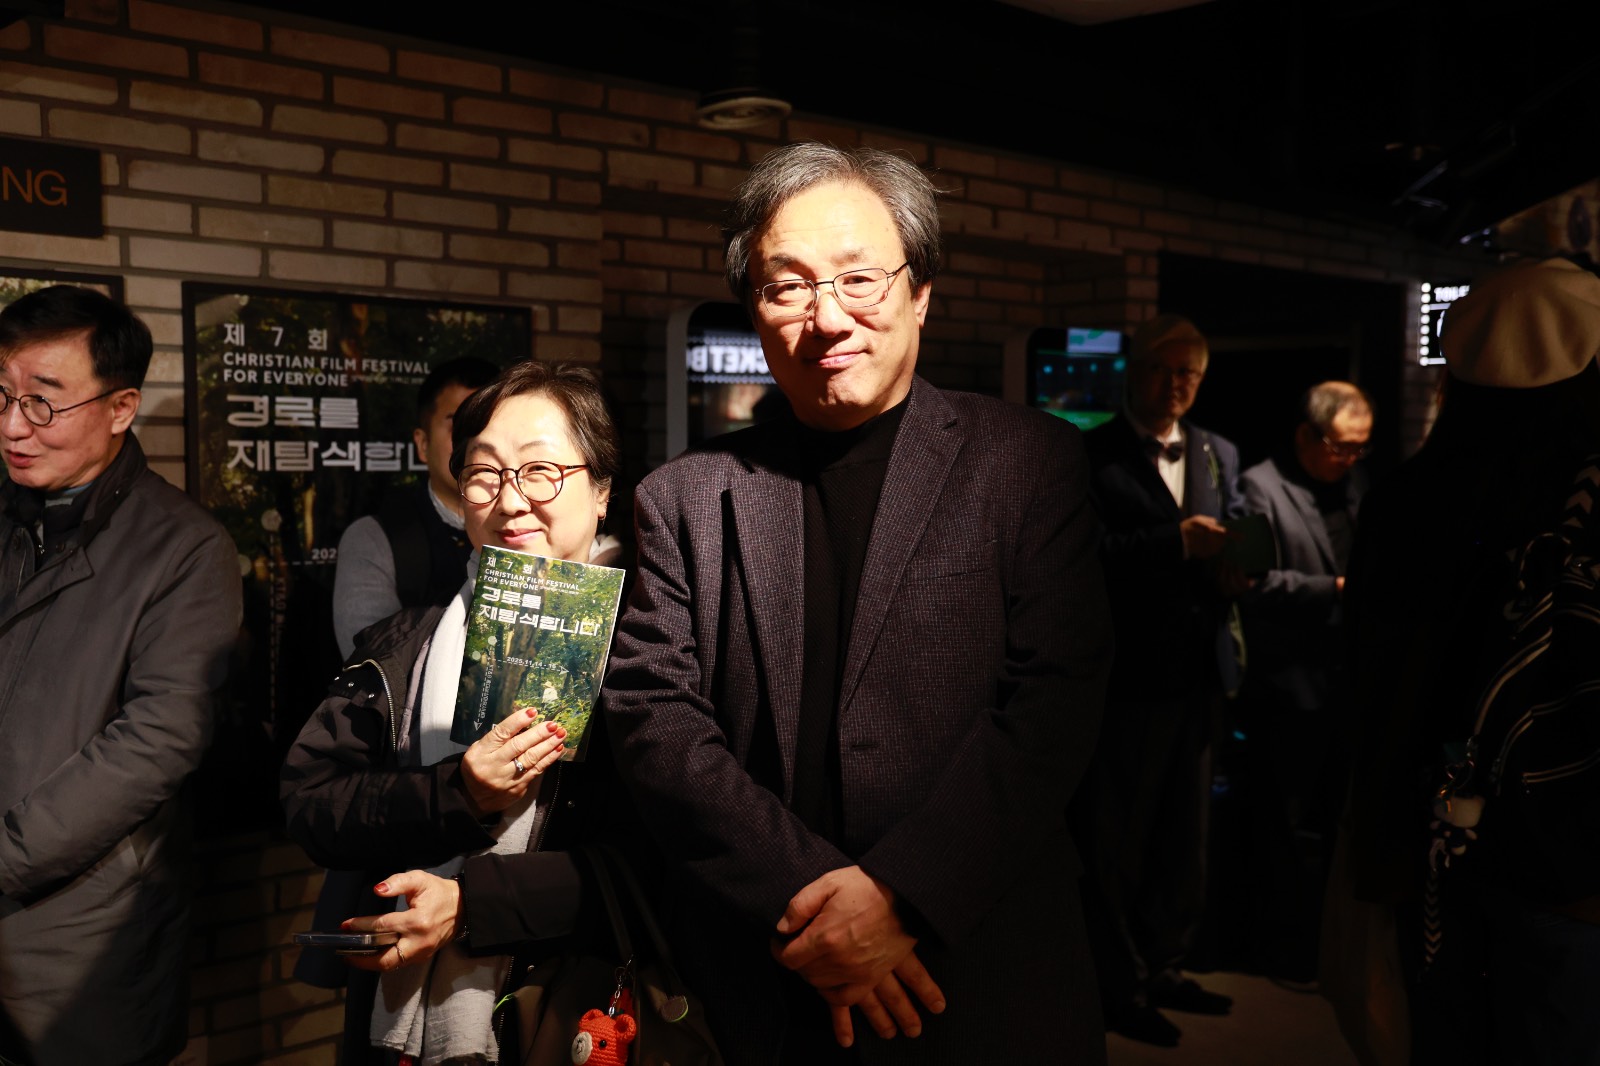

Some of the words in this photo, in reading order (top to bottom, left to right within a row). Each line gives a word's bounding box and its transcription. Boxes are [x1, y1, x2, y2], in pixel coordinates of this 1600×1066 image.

[223, 323, 245, 347] 제
[271, 326, 284, 347] 7
[308, 328, 328, 351] 회
[223, 352, 316, 369] CHRISTIAN
[320, 357, 357, 372] FILM
[361, 358, 432, 375] FESTIVAL
[223, 369, 258, 384] FOR
[263, 370, 349, 388] EVERYONE
[226, 394, 360, 430] 경로를
[227, 440, 429, 473] 재탐색합
[311, 548, 337, 561] 202
[486, 556, 497, 568] 제
[506, 561, 514, 570] 7
[522, 563, 534, 575] 회
[483, 575, 498, 584] FOR
[499, 578, 539, 591] EVERYONE
[485, 568, 525, 582] CHRISTIAN
[526, 576, 544, 585] FILM
[546, 579, 580, 591] FESTIVAL
[481, 585, 542, 610] 경로를
[477, 603, 601, 637] 재탐색합니다
